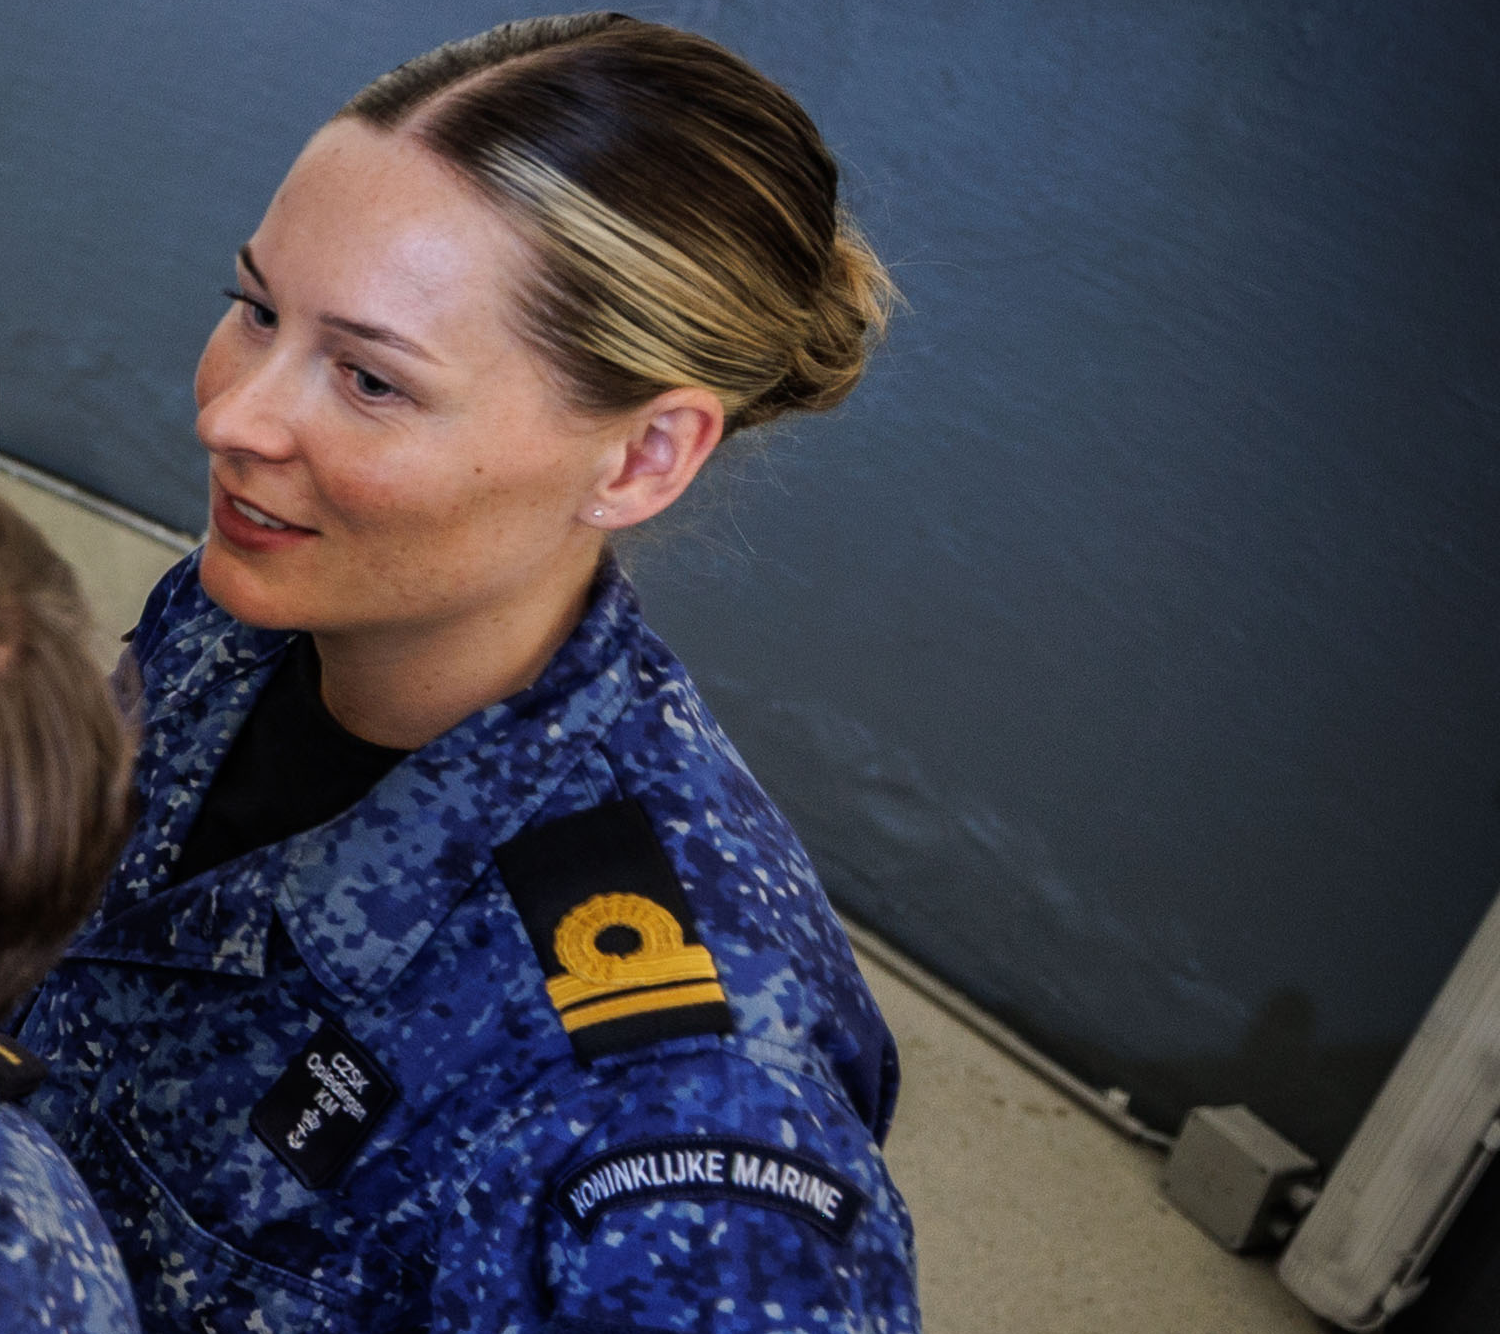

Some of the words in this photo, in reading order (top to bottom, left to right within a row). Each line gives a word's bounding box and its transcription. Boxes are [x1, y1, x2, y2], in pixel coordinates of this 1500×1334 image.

[332, 1052, 370, 1095] CZSK
[314, 1088, 340, 1116] KM
[569, 1149, 725, 1217] KONINKLIJKE
[731, 1151, 843, 1220] MARINE
